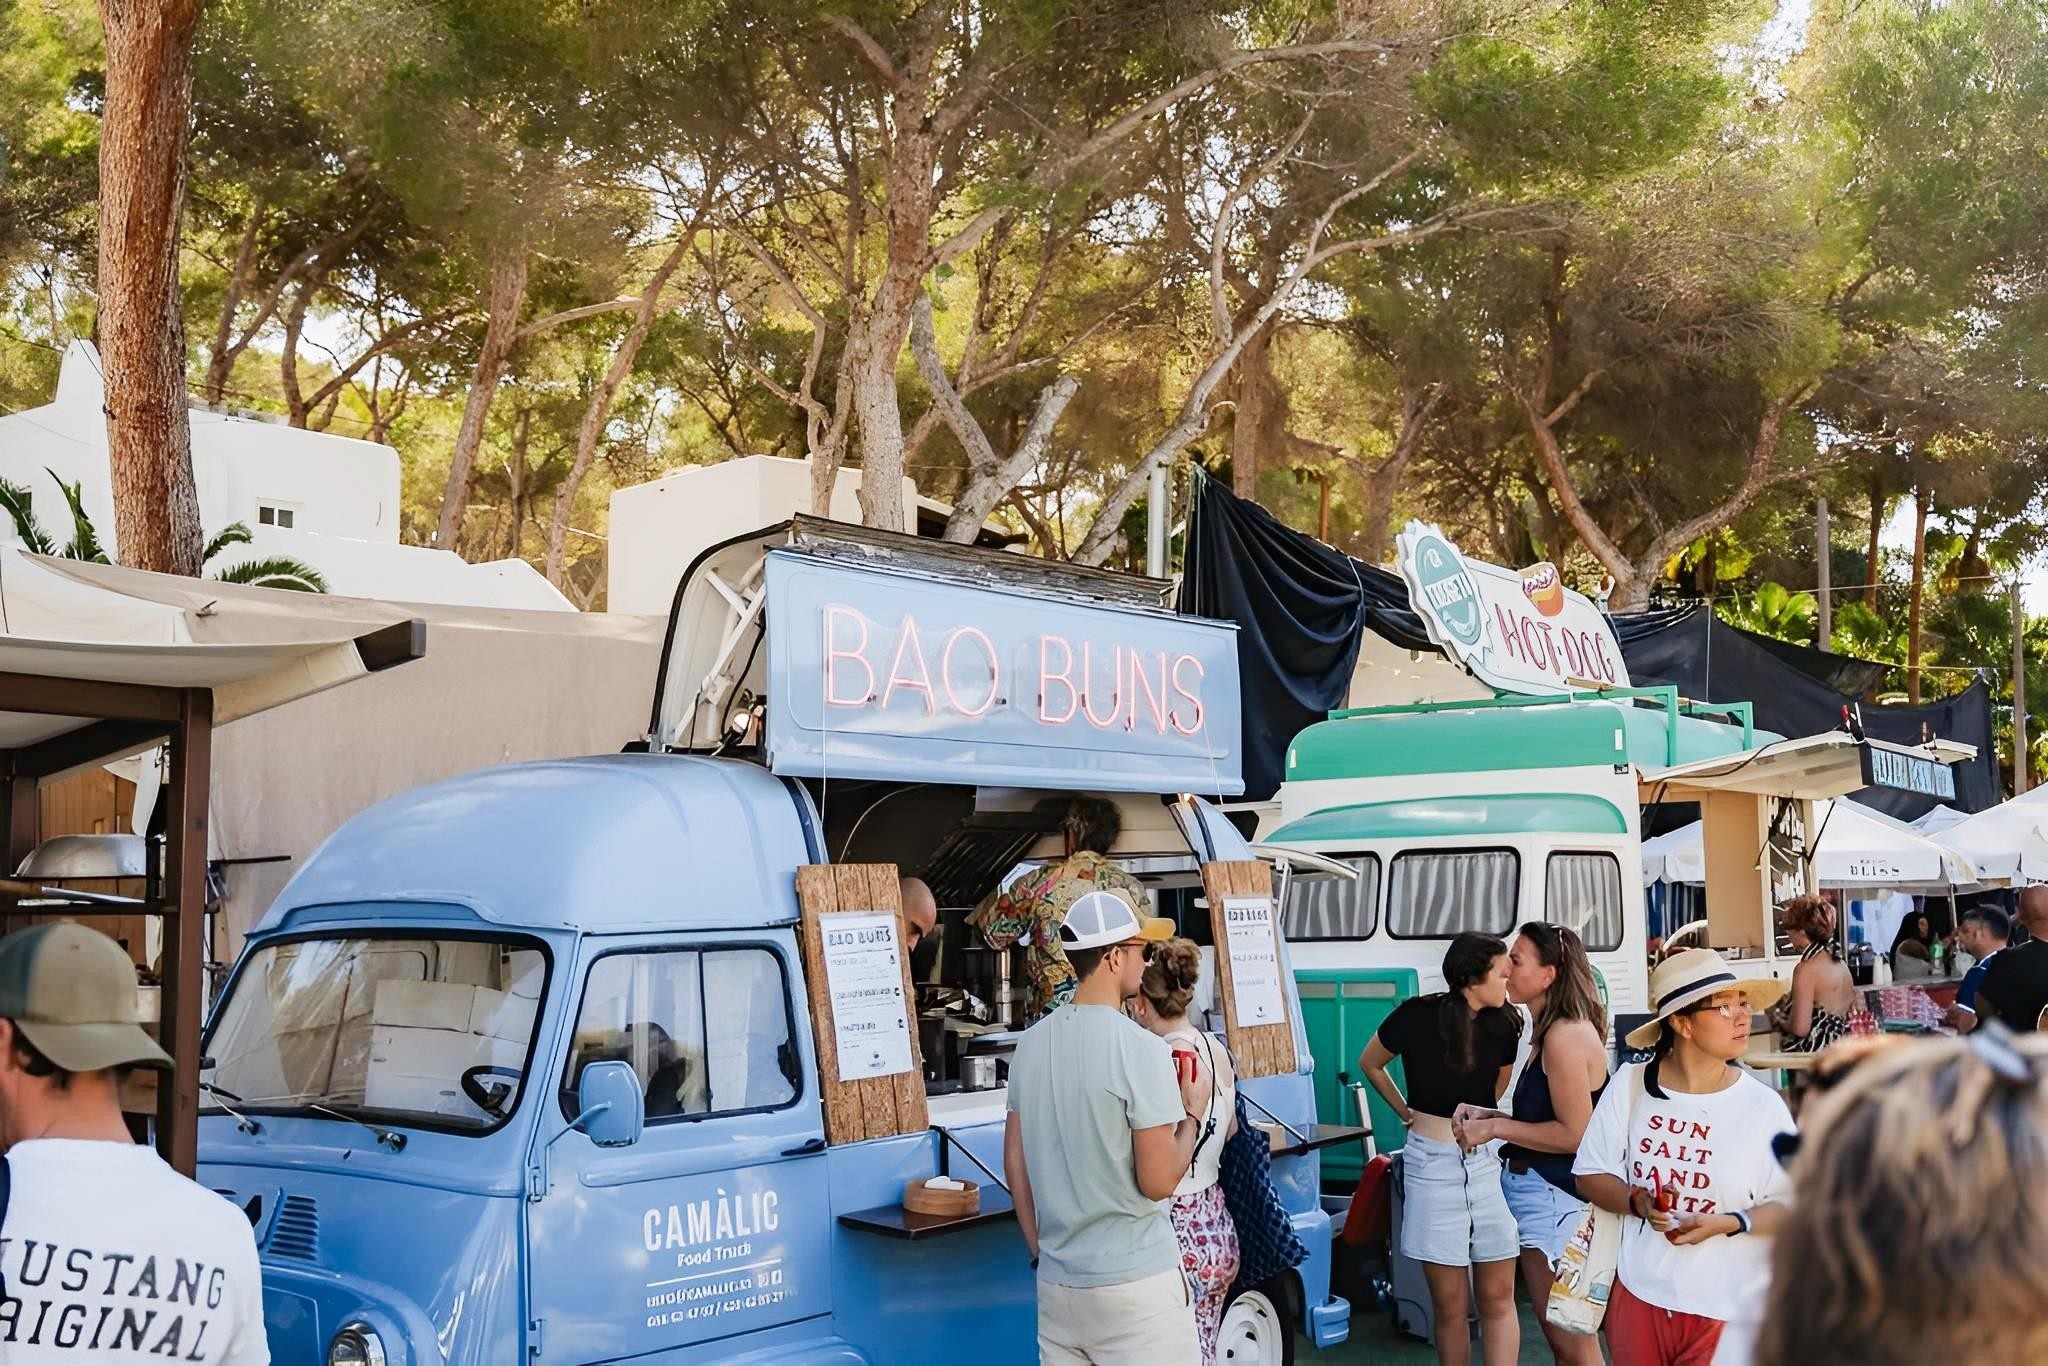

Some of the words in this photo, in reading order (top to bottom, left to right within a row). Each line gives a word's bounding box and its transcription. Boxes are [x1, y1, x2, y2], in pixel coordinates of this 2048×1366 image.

[822, 602, 1000, 718] BAO
[1039, 634, 1205, 736] BUNS
[1648, 1114, 1711, 1140] SUN
[1640, 1137, 1712, 1165] SALT
[1633, 1160, 1711, 1189] SAND
[643, 1187, 779, 1252] CAMÀLIC
[677, 1248, 712, 1267] Food
[0, 1238, 225, 1310] USTANG
